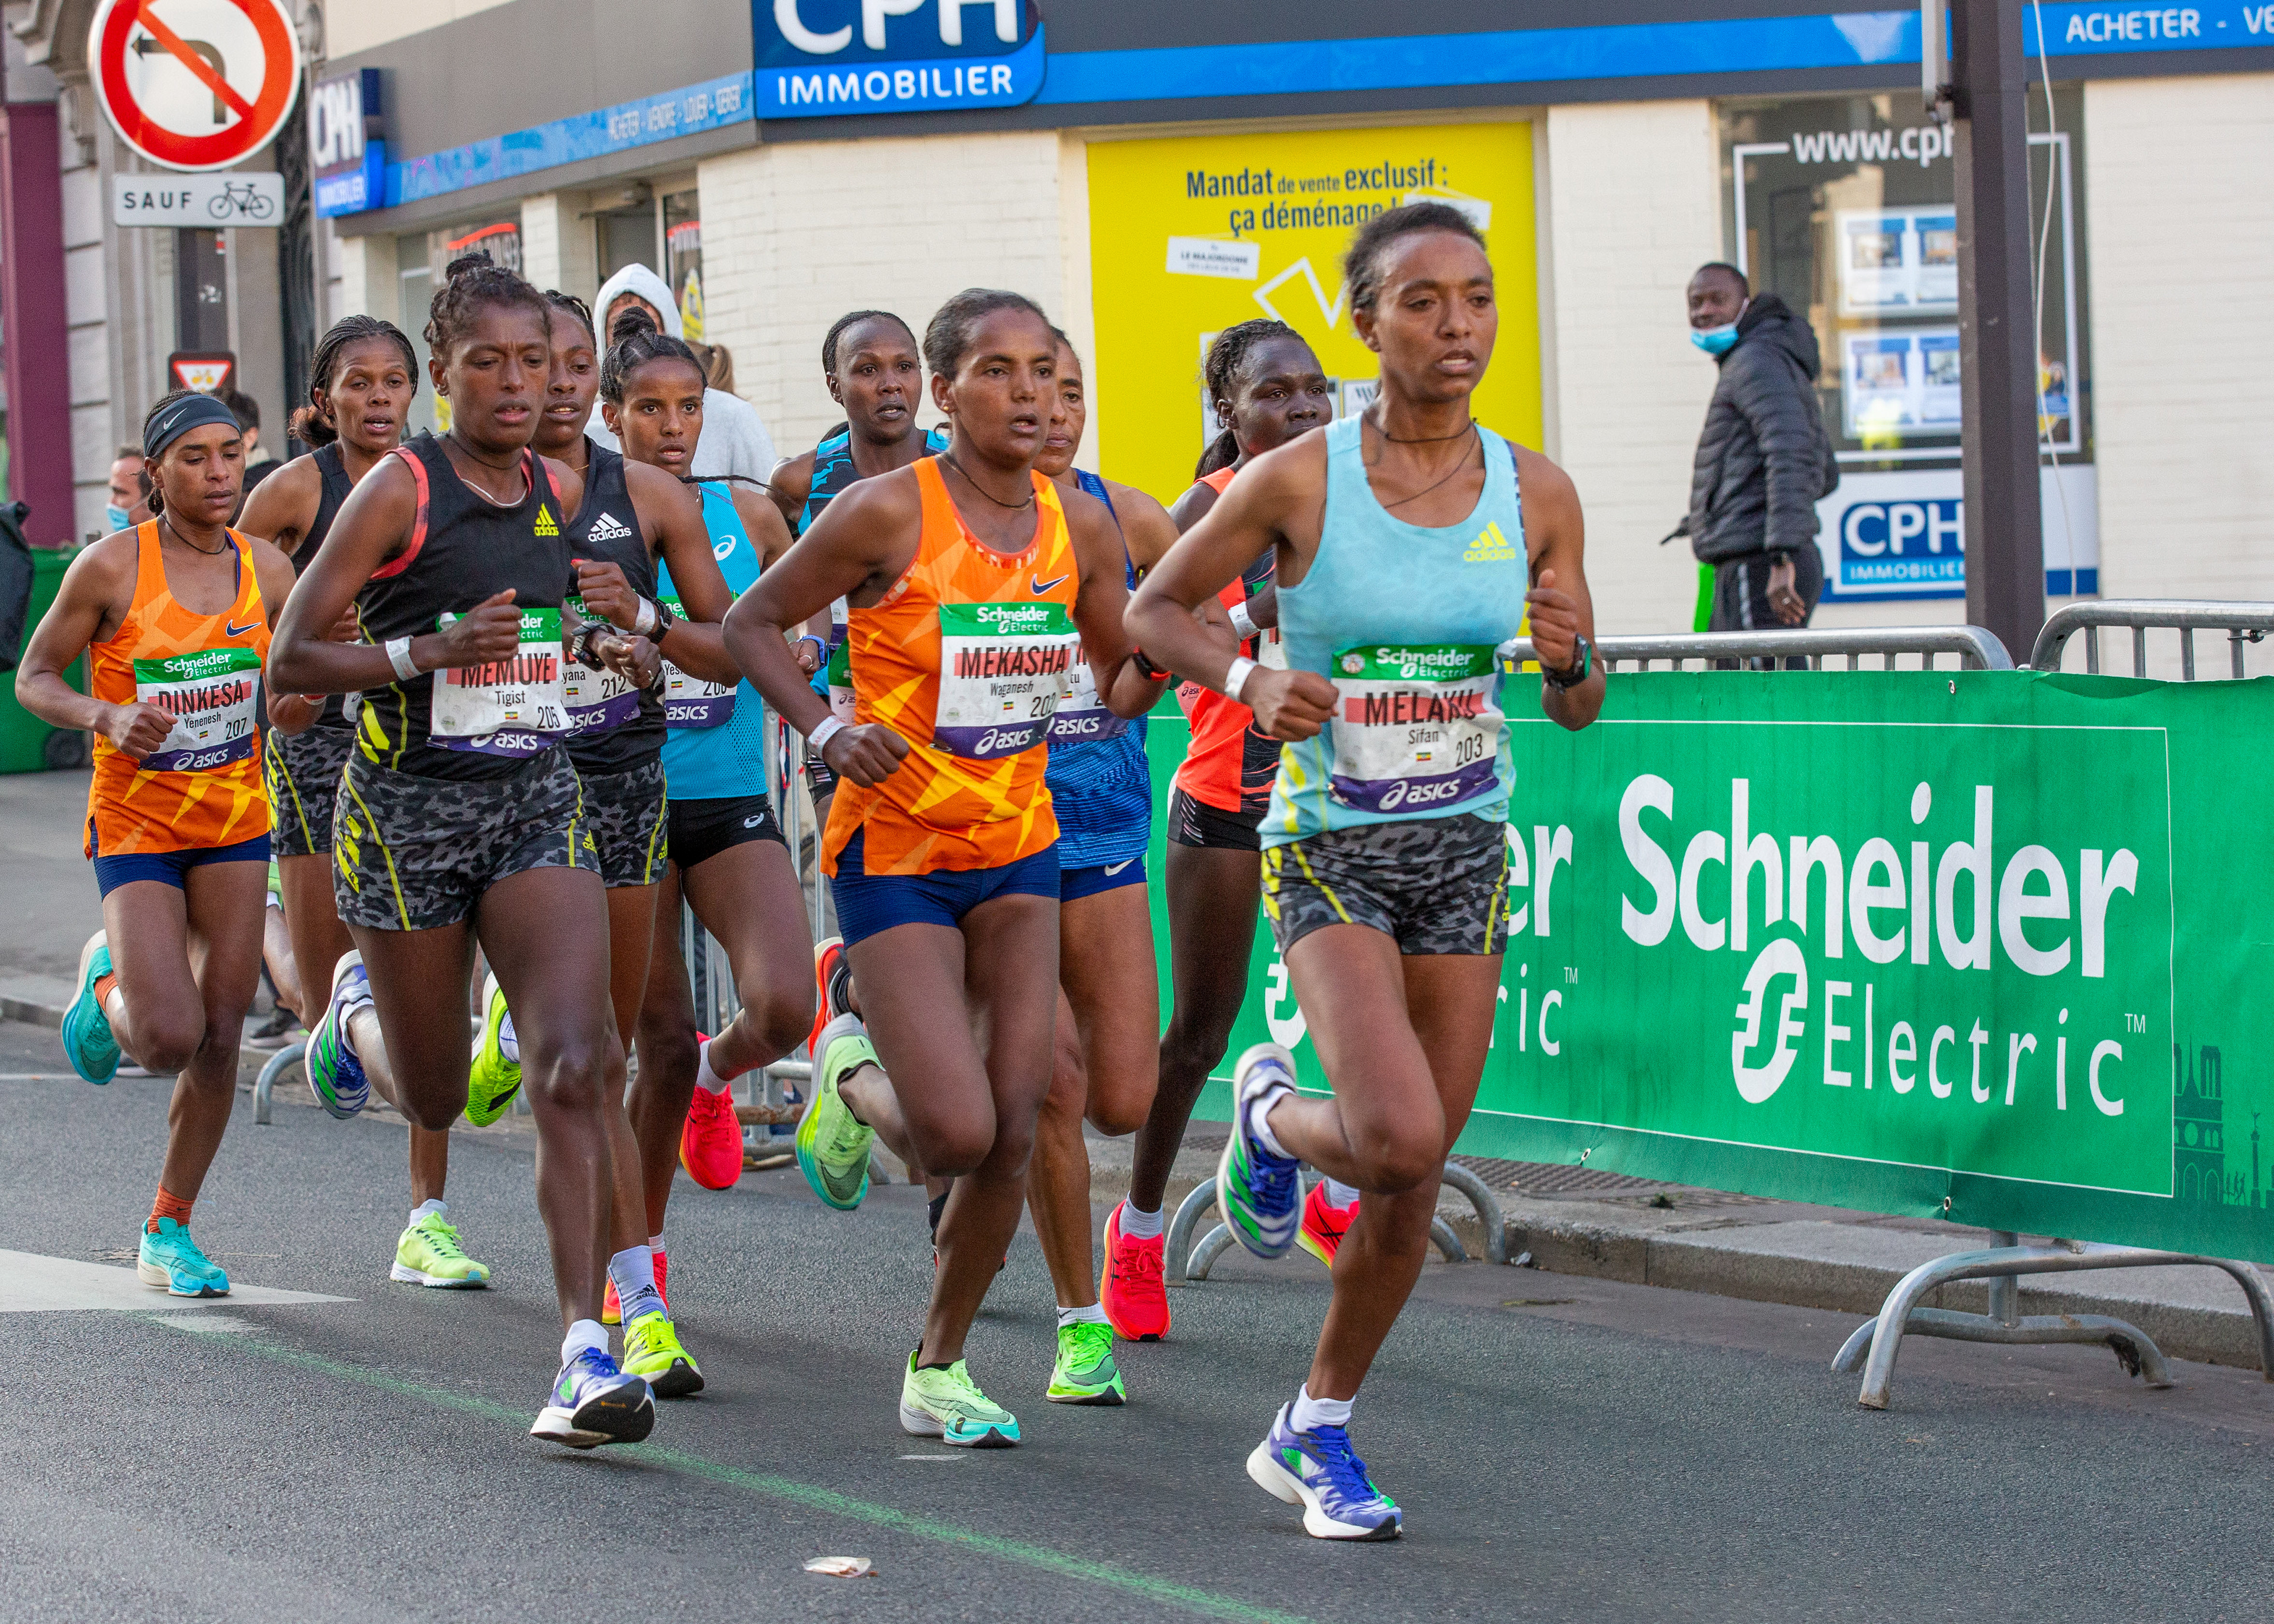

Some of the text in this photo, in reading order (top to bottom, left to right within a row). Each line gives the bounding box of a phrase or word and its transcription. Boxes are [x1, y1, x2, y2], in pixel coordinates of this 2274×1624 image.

[2066, 9, 2201, 43] ACHETER
[778, 64, 1013, 105] IMMOBILIER
[311, 77, 362, 168] CPH
[1186, 168, 1273, 198] Mandat
[1277, 177, 1296, 194] de
[1298, 174, 1341, 193] vente
[1344, 158, 1435, 191] exclusif
[124, 191, 192, 209] SAUF
[1229, 208, 1255, 237] ça
[534, 524, 560, 536] adidas
[587, 527, 632, 542] adidas
[1845, 501, 1965, 557] CPH
[1463, 547, 1515, 562] adidas
[977, 606, 1049, 623] Schneider
[1010, 622, 1048, 632] Electric
[164, 652, 231, 673] Schneider
[961, 644, 1066, 679] MEKASHA
[1376, 647, 1474, 667] Schneider
[195, 664, 232, 677] Electric
[461, 652, 551, 688] MEMUYE
[1419, 665, 1470, 677] Electric
[159, 679, 243, 716] DINKESA
[602, 675, 626, 700] 212
[990, 681, 1034, 697] Waganesh
[496, 690, 525, 707] Tigist
[1365, 689, 1476, 727] MELAKU
[184, 712, 221, 729] Yenenesh
[537, 706, 561, 729] 205
[666, 705, 709, 721] asics
[226, 716, 248, 741] 207
[1054, 717, 1100, 735] asics
[495, 733, 538, 751] asics
[995, 729, 1033, 750] asics
[1408, 729, 1439, 745] Sifan
[194, 748, 229, 768] asics
[1456, 733, 1483, 767] 203
[1406, 779, 1462, 804] asics
[1618, 774, 2139, 979] Schneider
[1823, 980, 2124, 1117] Electric
